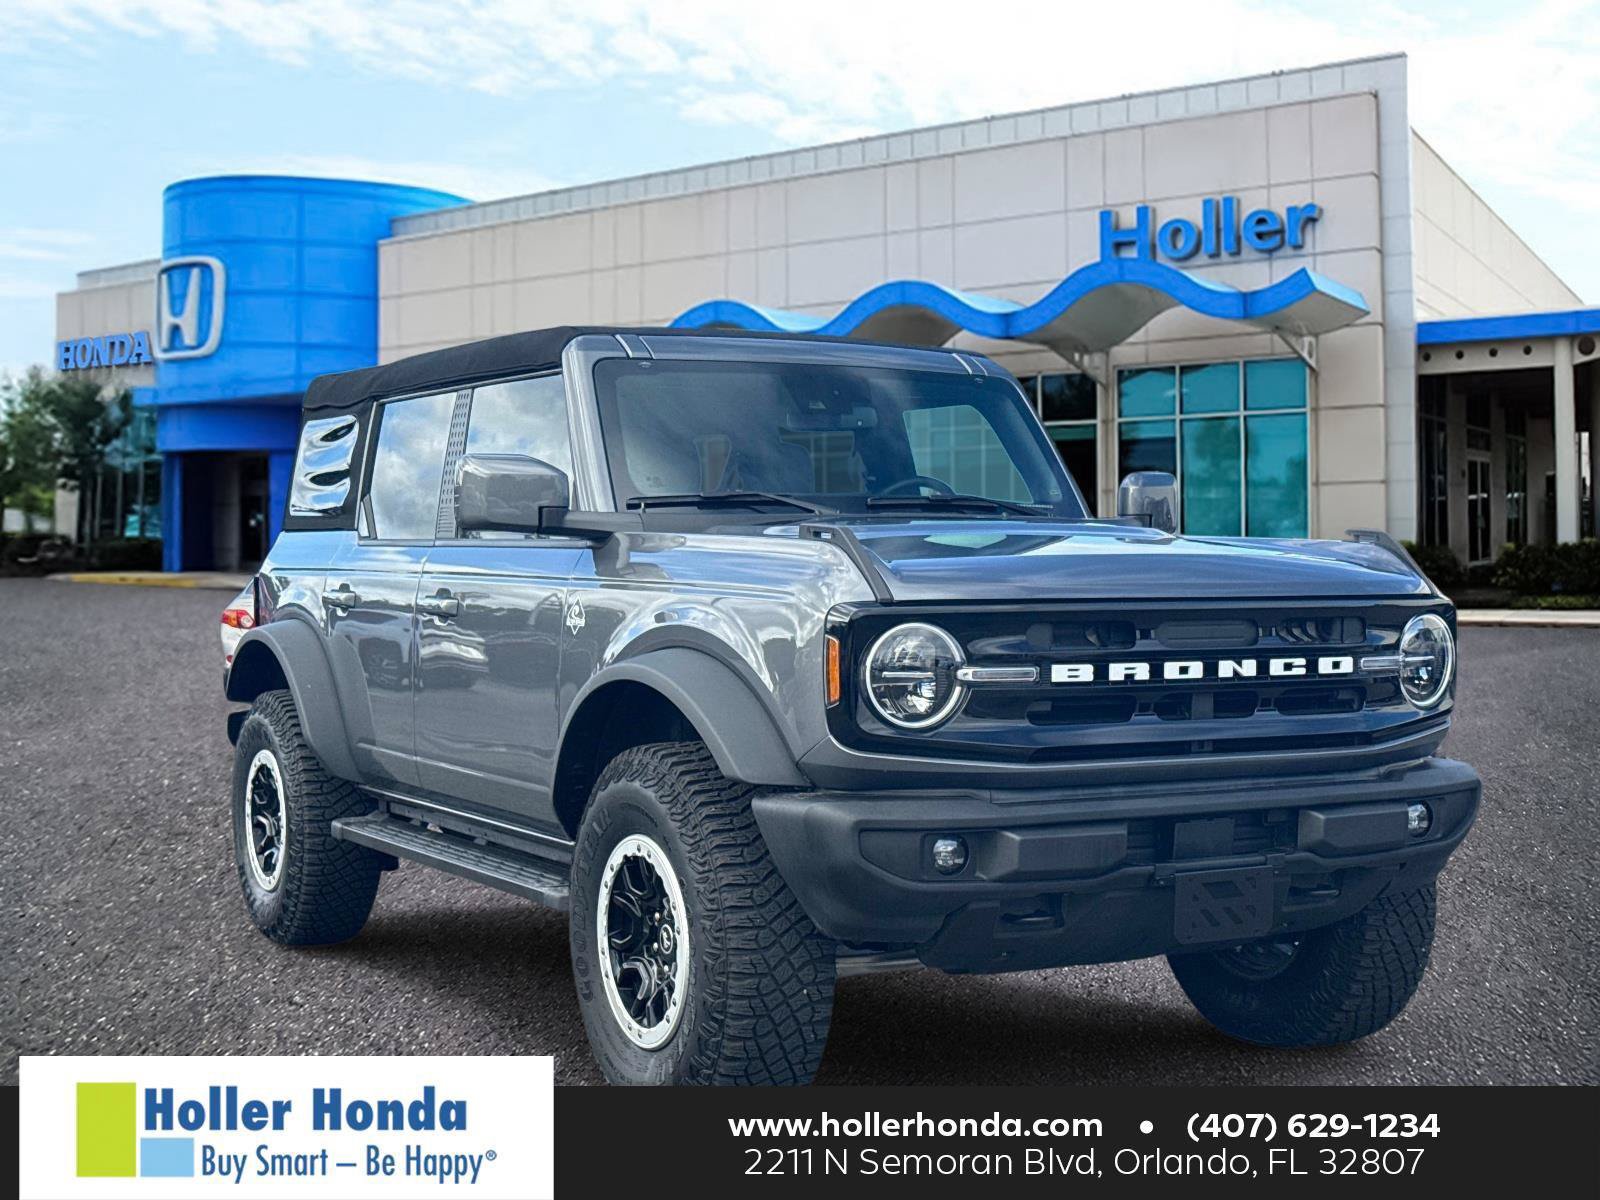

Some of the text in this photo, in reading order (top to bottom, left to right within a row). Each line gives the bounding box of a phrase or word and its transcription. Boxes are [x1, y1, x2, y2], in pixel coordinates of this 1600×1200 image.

[1099, 196, 1322, 262] Holler
[57, 331, 152, 371] HONDA
[1051, 656, 1354, 683] BRONCO
